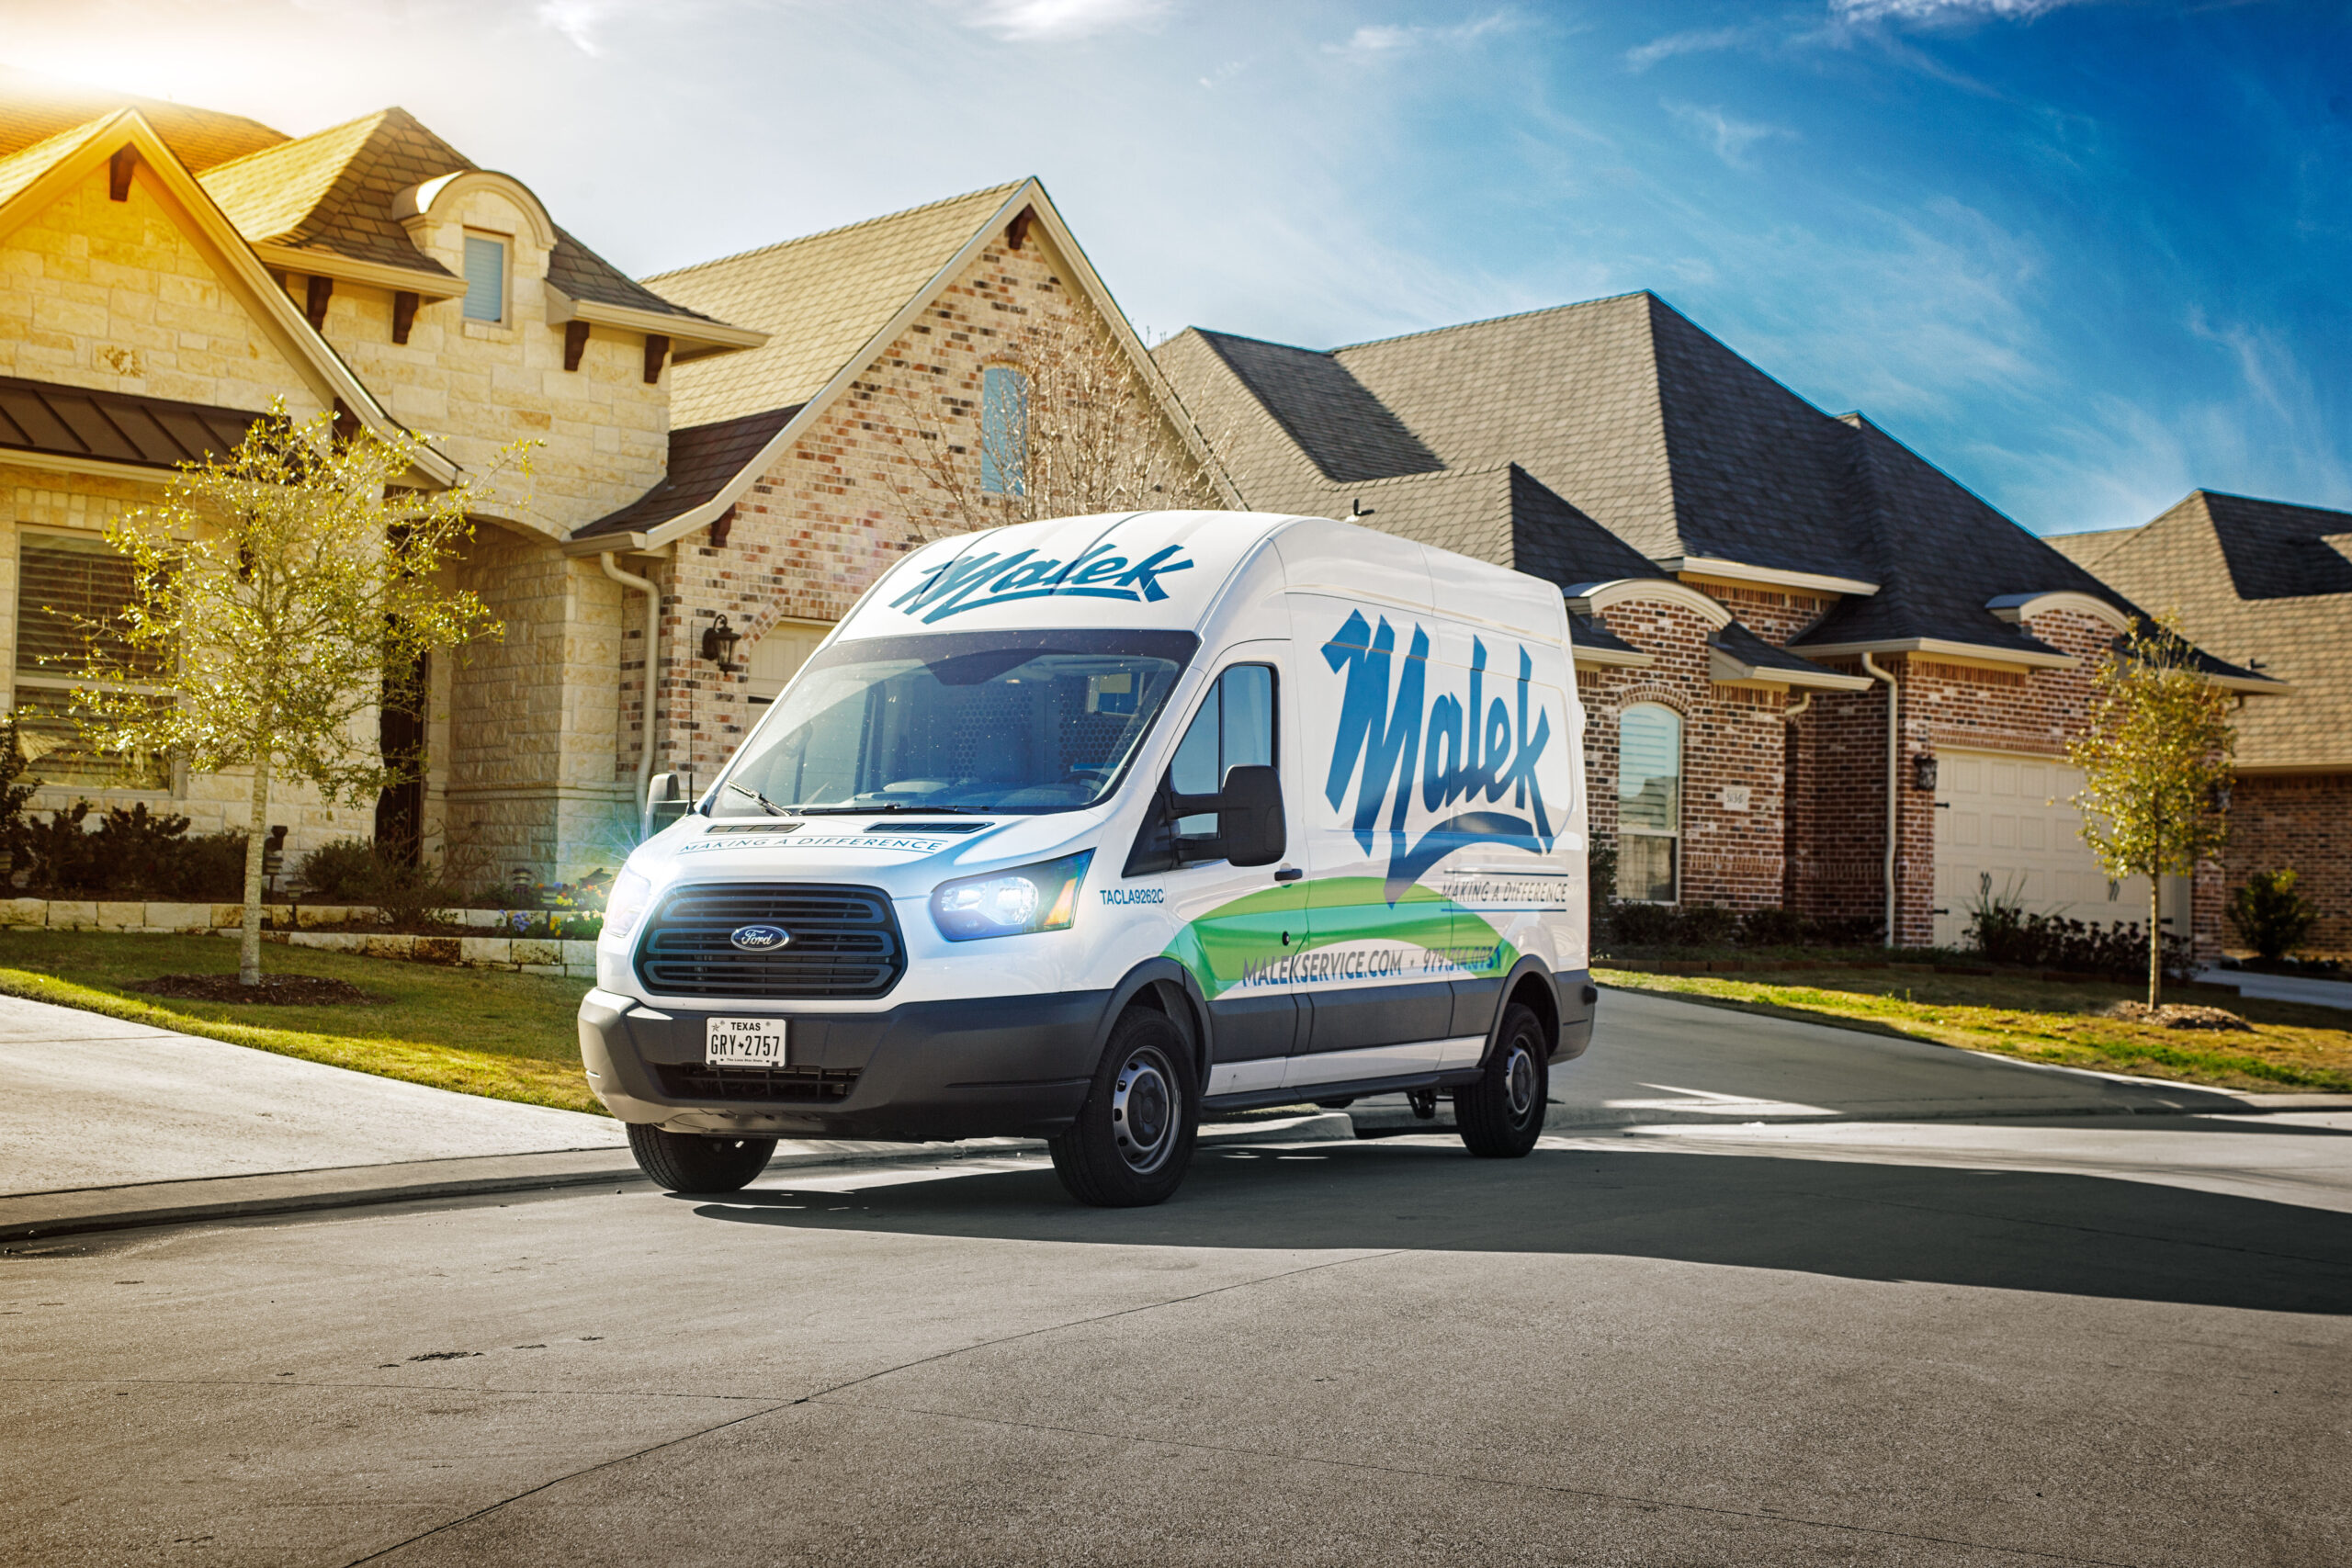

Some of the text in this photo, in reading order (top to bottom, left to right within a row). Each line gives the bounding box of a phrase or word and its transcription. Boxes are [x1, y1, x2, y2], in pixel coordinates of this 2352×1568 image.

[888, 544, 1194, 625] Malek
[1320, 608, 1555, 910] Malek
[680, 839, 769, 852] MAKING
[797, 838, 943, 851] DIFFERENCE
[1100, 888, 1164, 905] TACLA9262C
[1441, 882, 1567, 902] MAKING A DIFFERENCE
[741, 929, 774, 945] Ford
[1242, 949, 1404, 987] MALEKSERVICE.COM
[730, 1021, 762, 1032] TEXAS
